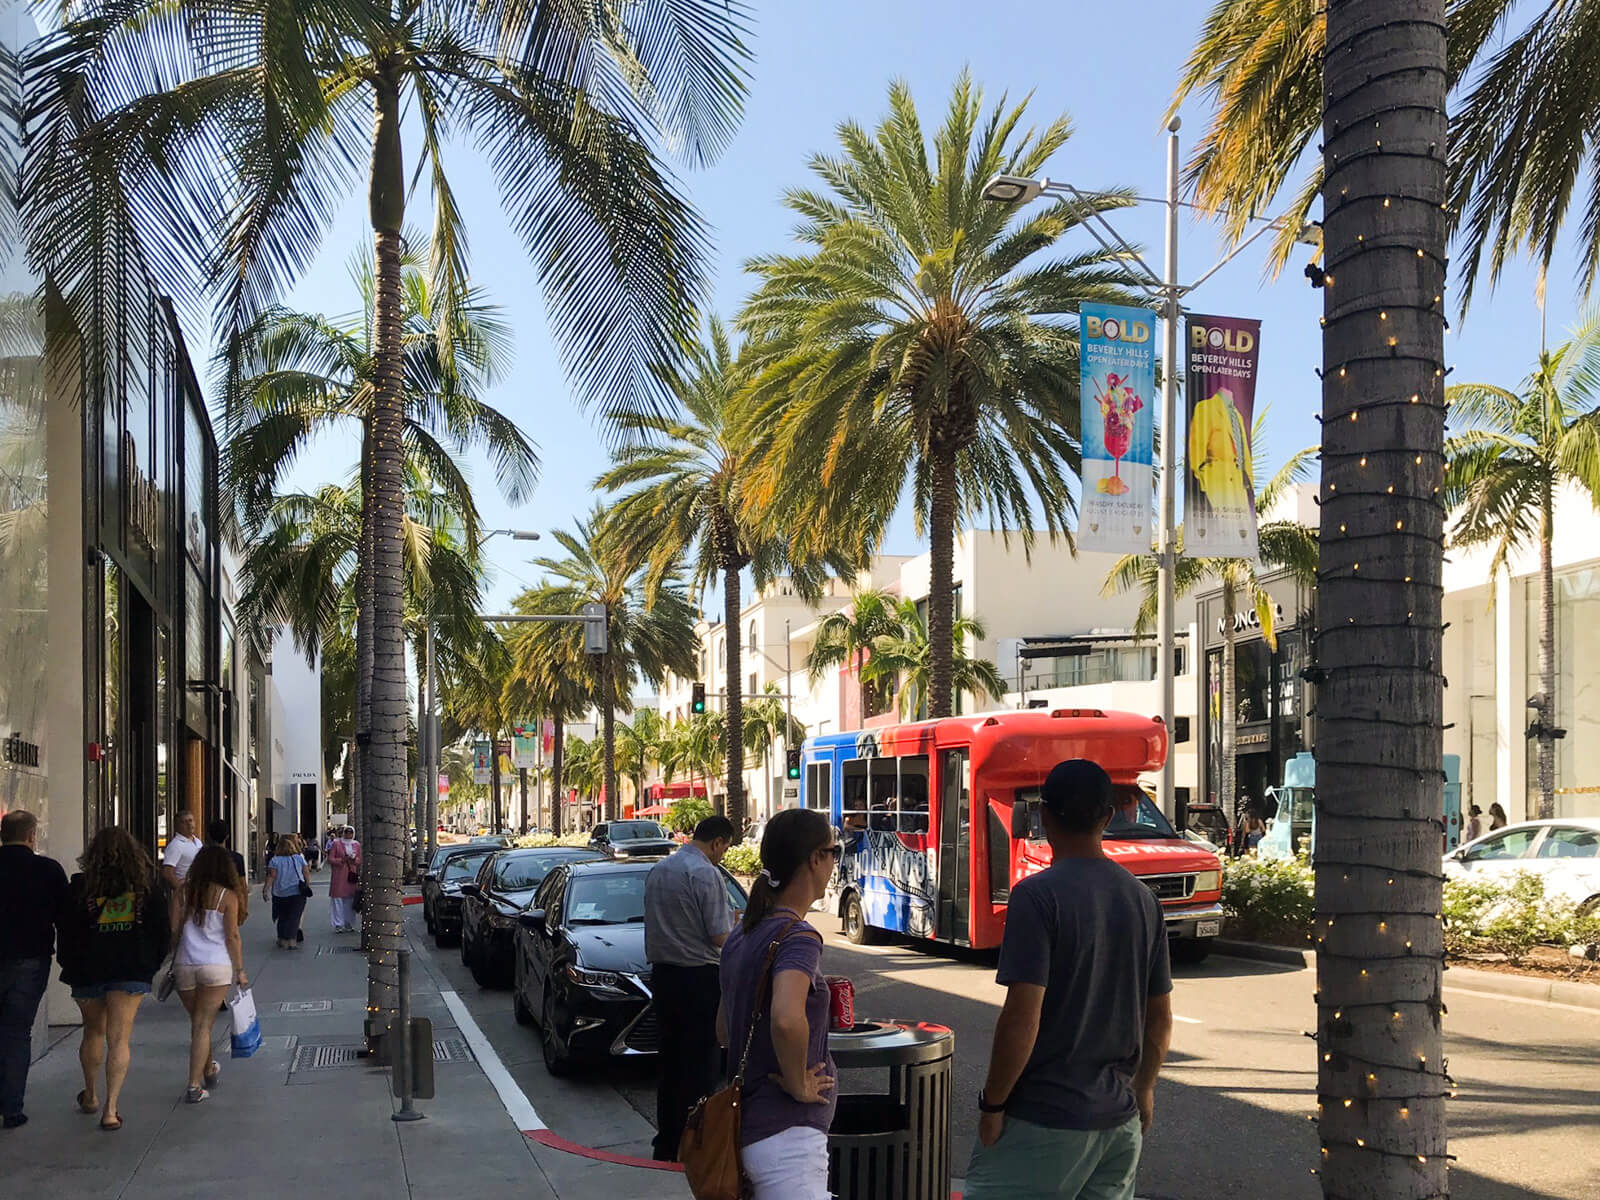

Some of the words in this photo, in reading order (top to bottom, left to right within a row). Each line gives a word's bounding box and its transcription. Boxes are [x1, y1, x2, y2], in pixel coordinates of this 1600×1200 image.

[1087, 316, 1149, 343] BOLD
[1191, 325, 1254, 353] BOLD
[1088, 344, 1124, 356] BEVERLY
[1126, 348, 1149, 359] HILLS
[1087, 355, 1110, 364] OPEN
[1130, 361, 1149, 369] DAYS
[1191, 353, 1228, 365] BEVERLY
[1229, 357, 1252, 368] HILLS
[1191, 365, 1212, 374] OPEN
[1233, 369, 1251, 378] DAYS
